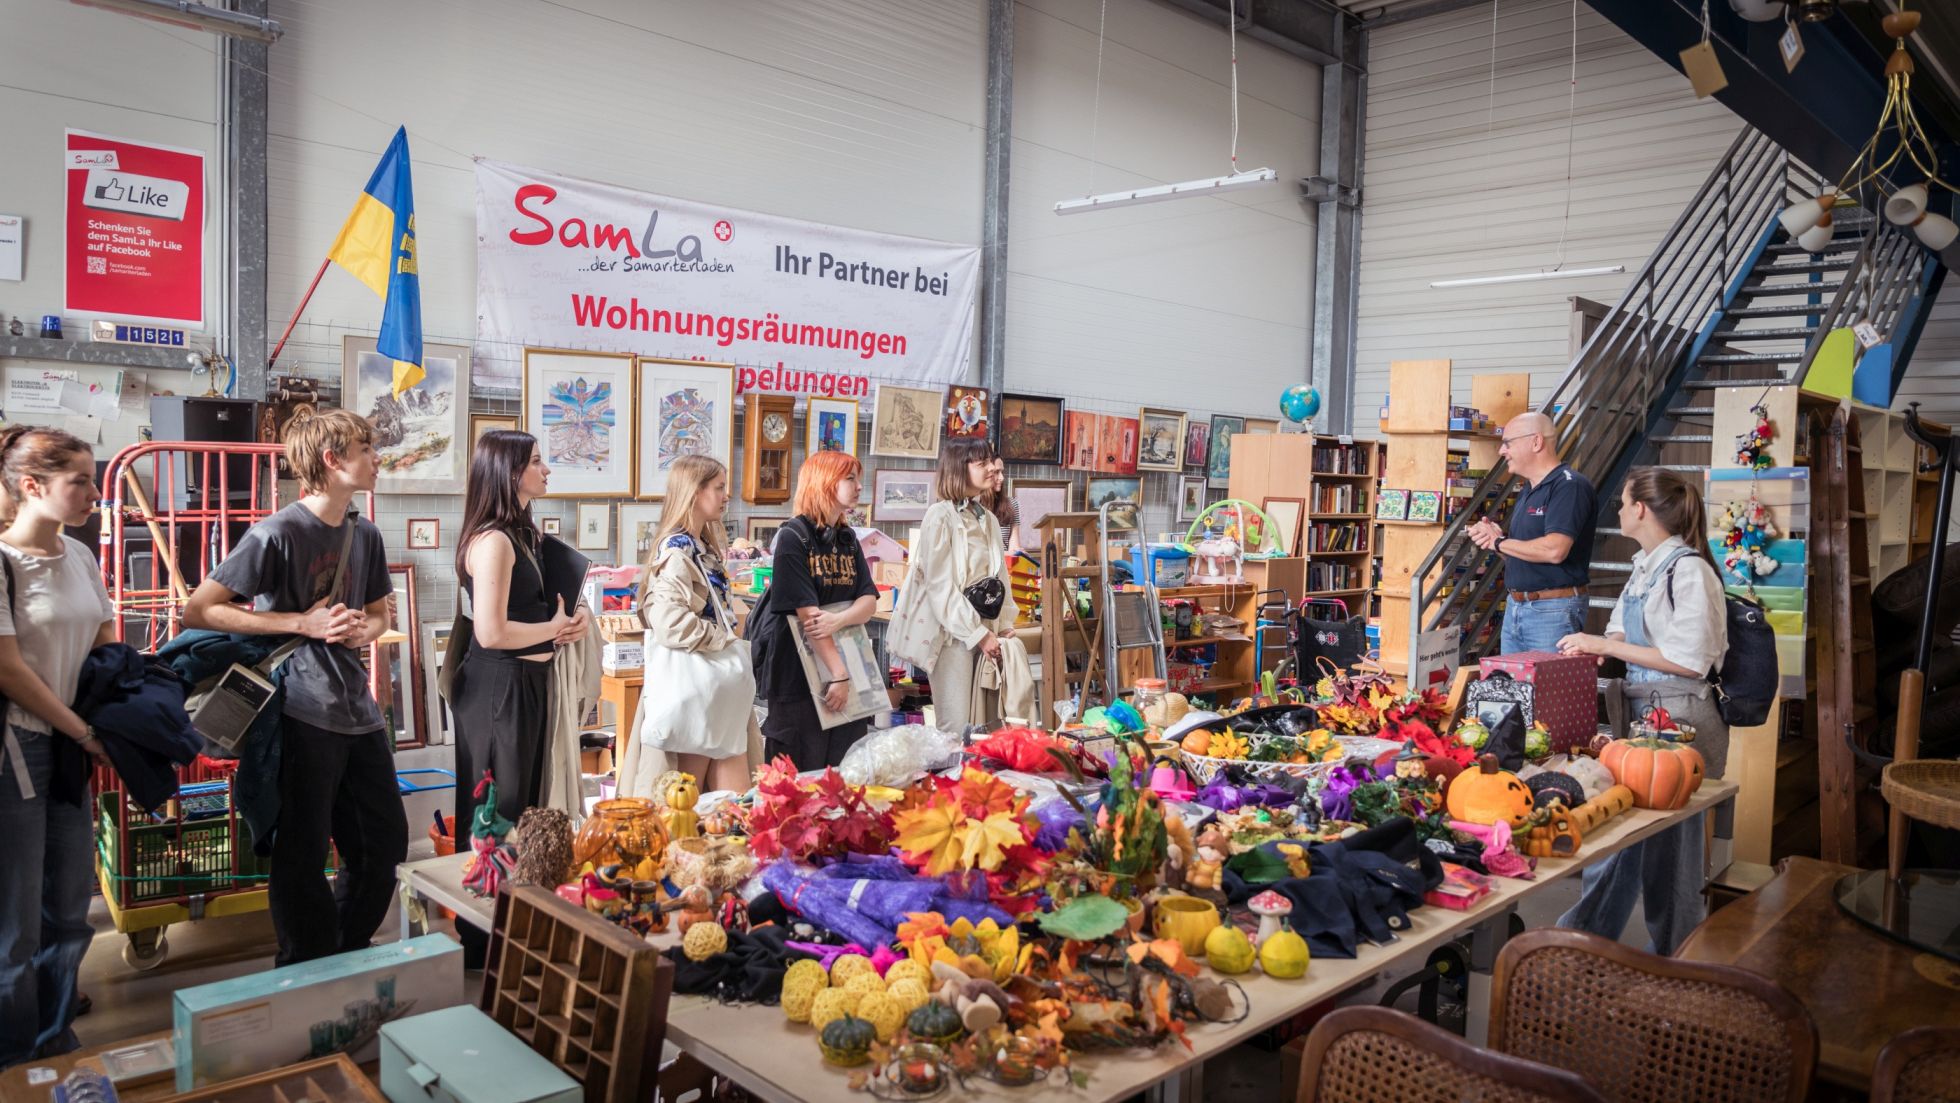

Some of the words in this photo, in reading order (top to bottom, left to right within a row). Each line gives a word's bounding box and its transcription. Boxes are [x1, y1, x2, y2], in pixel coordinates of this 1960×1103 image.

[127, 185, 168, 207] Like
[88, 220, 134, 233] Schenken
[137, 226, 151, 236] Sie
[509, 184, 703, 262] SamLa
[88, 232, 109, 241] dem
[112, 234, 145, 246] SamLa
[148, 238, 161, 248] Ihr
[163, 241, 182, 251] Like
[88, 242, 103, 252] auf
[105, 244, 151, 257] Facebook
[110, 262, 146, 271] facebook.com
[623, 255, 735, 273] Samariterladen
[775, 245, 812, 276] Ihr
[818, 252, 910, 290] Partner
[914, 266, 949, 297] bei
[571, 293, 907, 359] Wohnungsräumungen
[736, 361, 869, 397] pelungen
